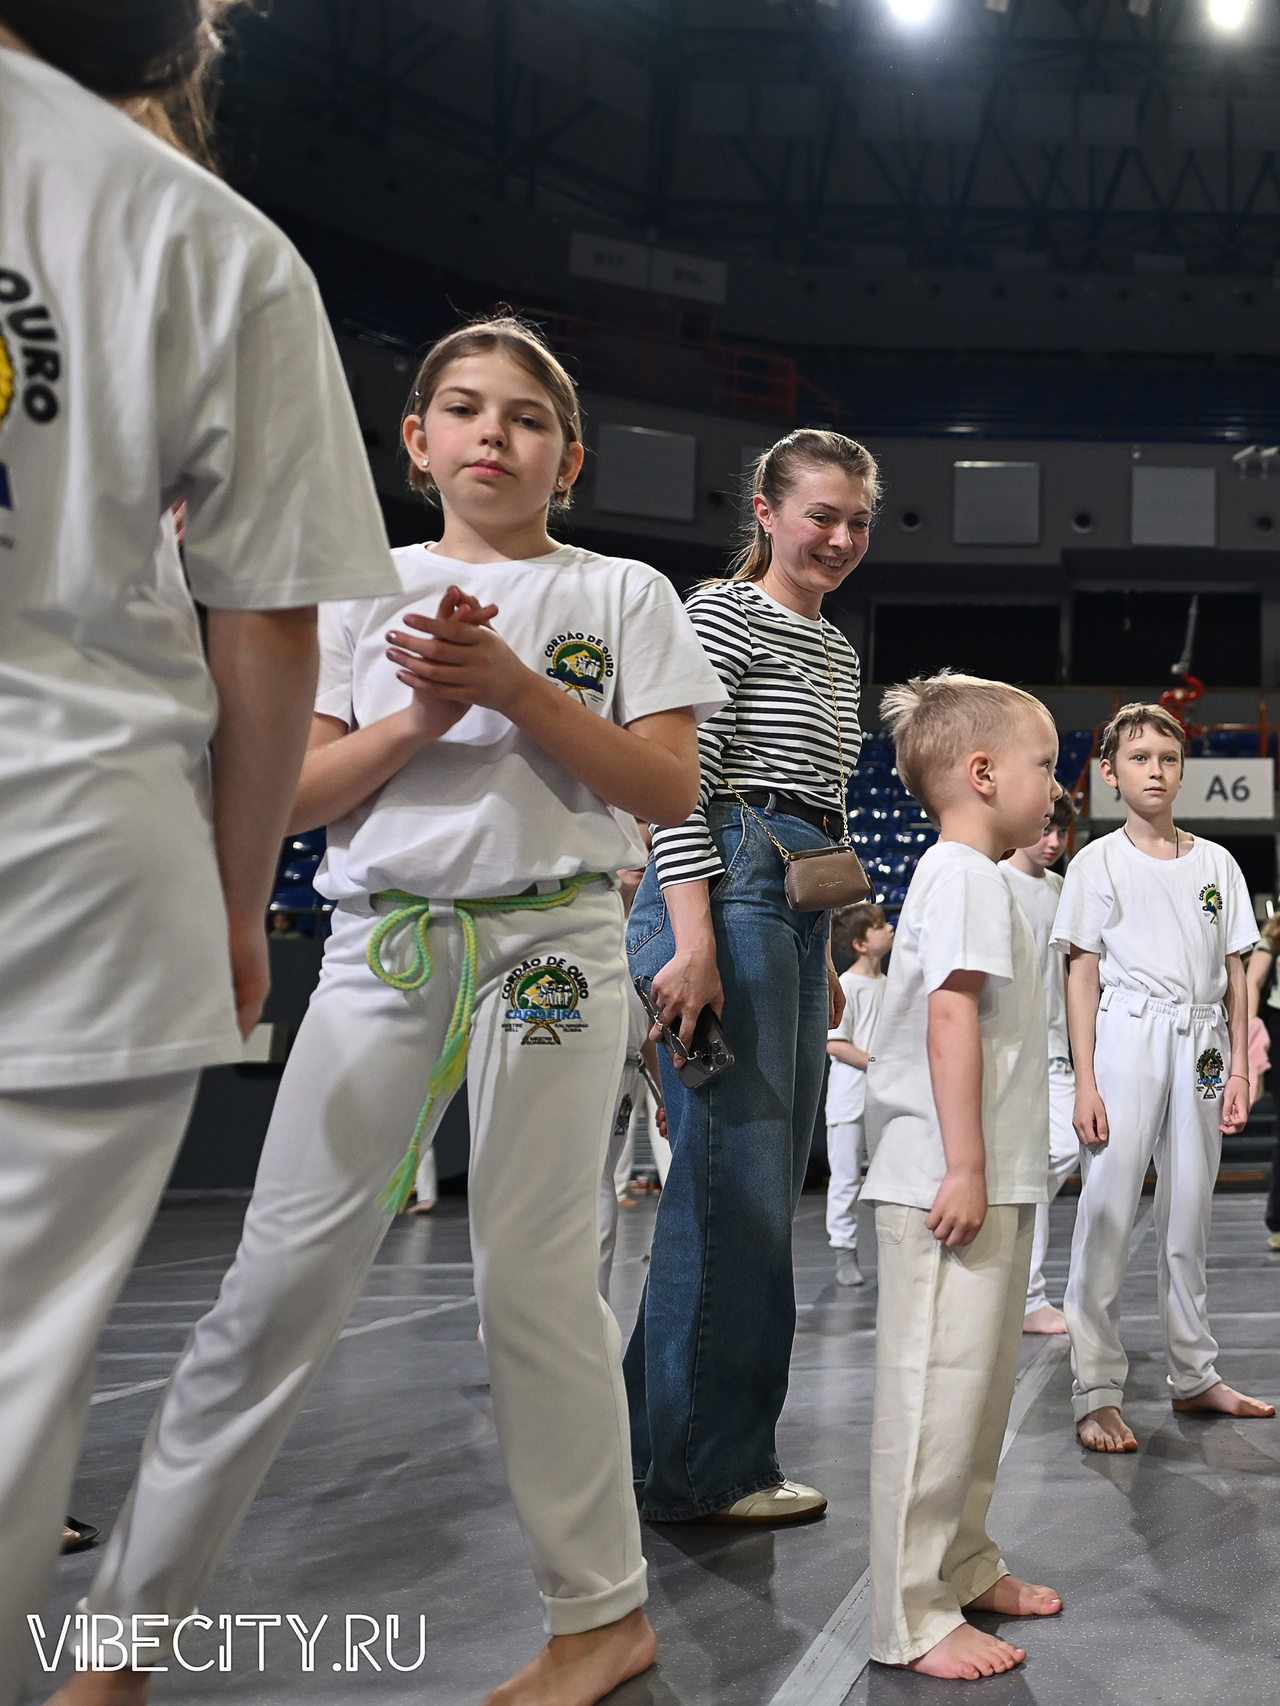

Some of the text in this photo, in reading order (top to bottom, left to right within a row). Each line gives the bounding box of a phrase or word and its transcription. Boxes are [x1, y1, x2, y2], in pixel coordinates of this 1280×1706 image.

[545, 631, 614, 678] CORDÃO DE OURO
[1205, 774, 1251, 802] A6
[546, 956, 567, 968] DE
[567, 965, 589, 999] OURO
[505, 1008, 582, 1020] CAPOEIRA
